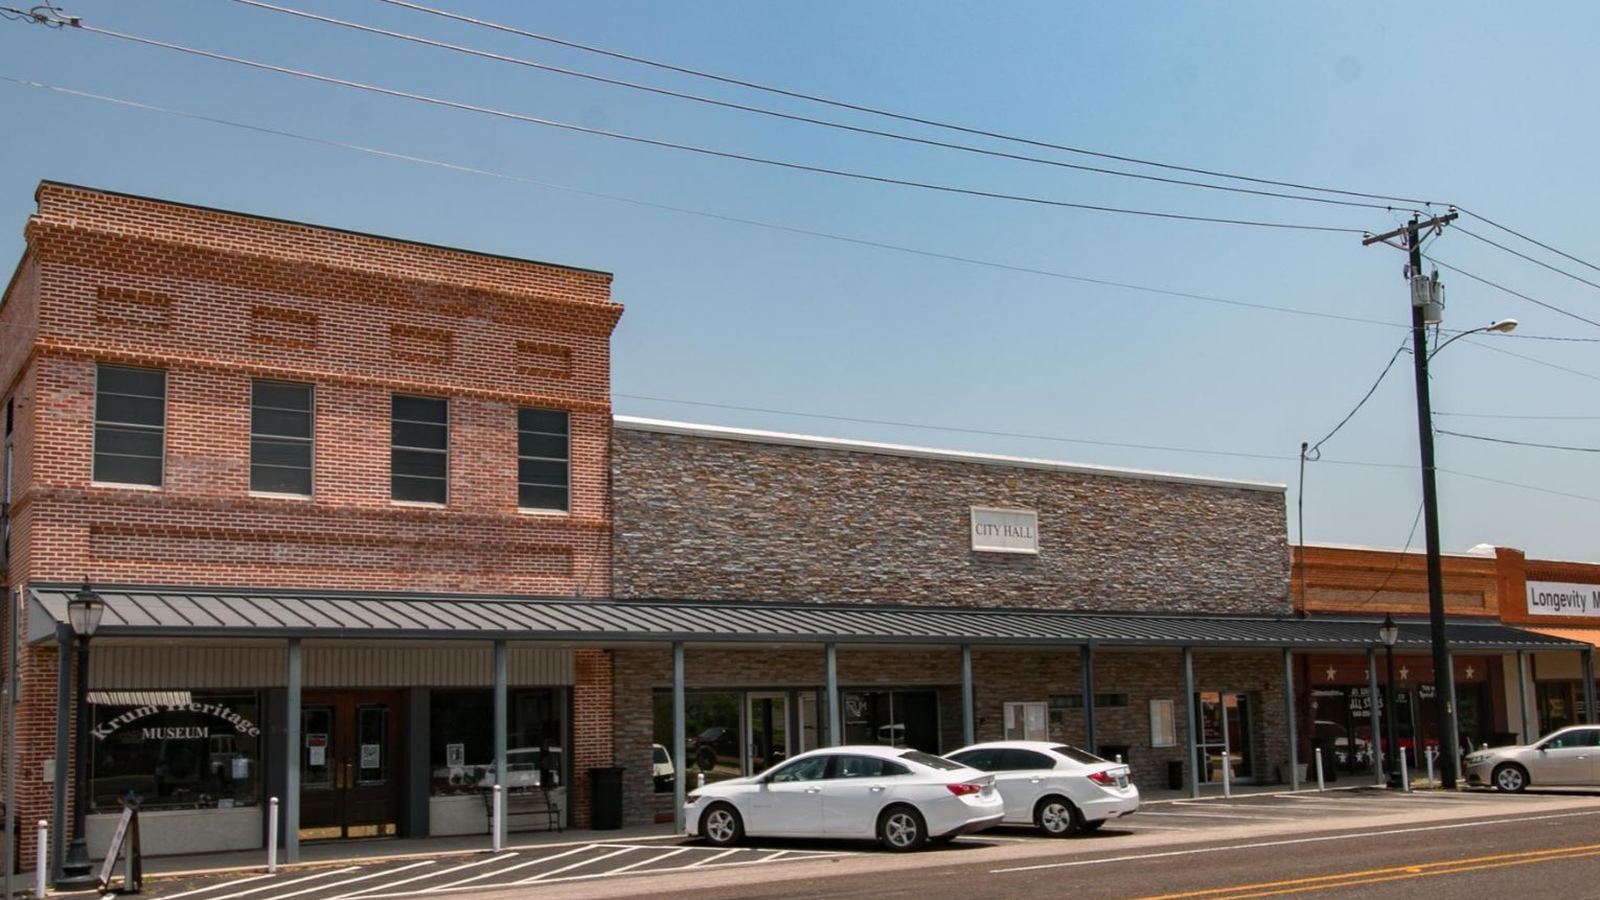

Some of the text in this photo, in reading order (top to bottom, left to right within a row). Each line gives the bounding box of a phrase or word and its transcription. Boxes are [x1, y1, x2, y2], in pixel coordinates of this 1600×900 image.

[975, 523, 1033, 539] CITY HALL
[1531, 587, 1587, 613] Longevity
[89, 704, 159, 741] Krum
[142, 726, 209, 740] MUSEUM
